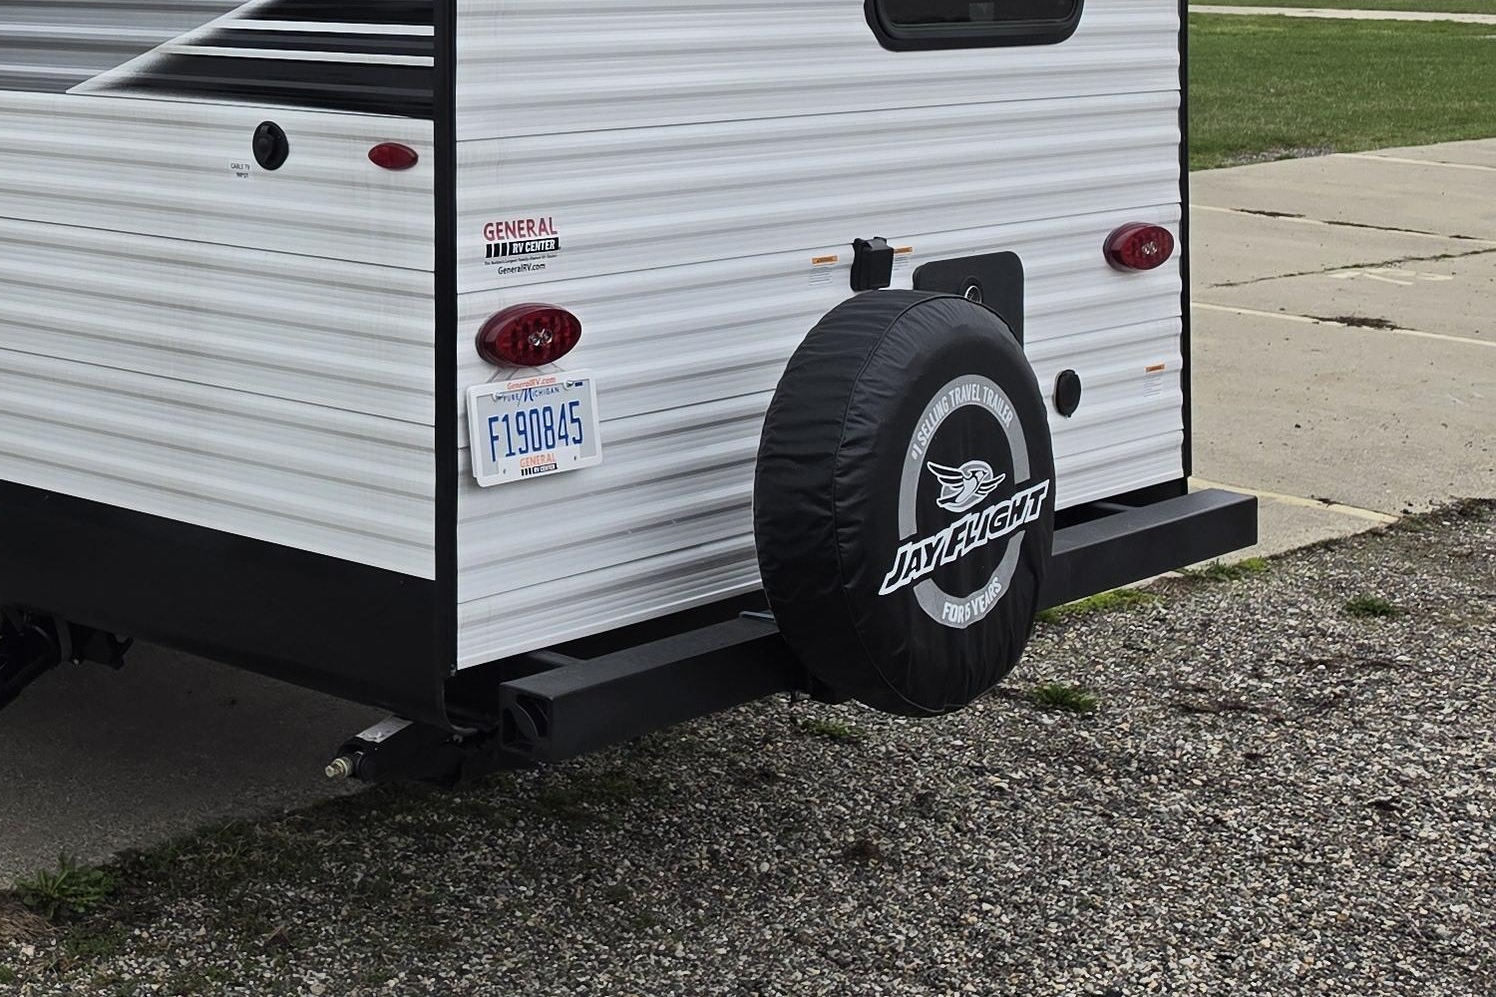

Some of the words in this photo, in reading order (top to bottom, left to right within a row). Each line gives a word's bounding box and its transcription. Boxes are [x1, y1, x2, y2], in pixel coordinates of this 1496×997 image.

[483, 216, 558, 241] GENERAL
[512, 242, 524, 253] RV
[525, 239, 556, 253] CENTER
[497, 262, 546, 275] GeneralRV.com
[506, 377, 557, 391] GeneralRV.com
[487, 400, 585, 463] F190845
[909, 442, 923, 461] #1
[916, 396, 951, 445] SELLING
[948, 383, 982, 407] TRAVEL
[982, 386, 1014, 429] TRAILER
[519, 452, 556, 468] GENERAL
[878, 531, 946, 596] JAY
[940, 479, 1050, 566] FLIGHT
[942, 601, 964, 623] FOR
[970, 576, 1002, 616] YEARS
